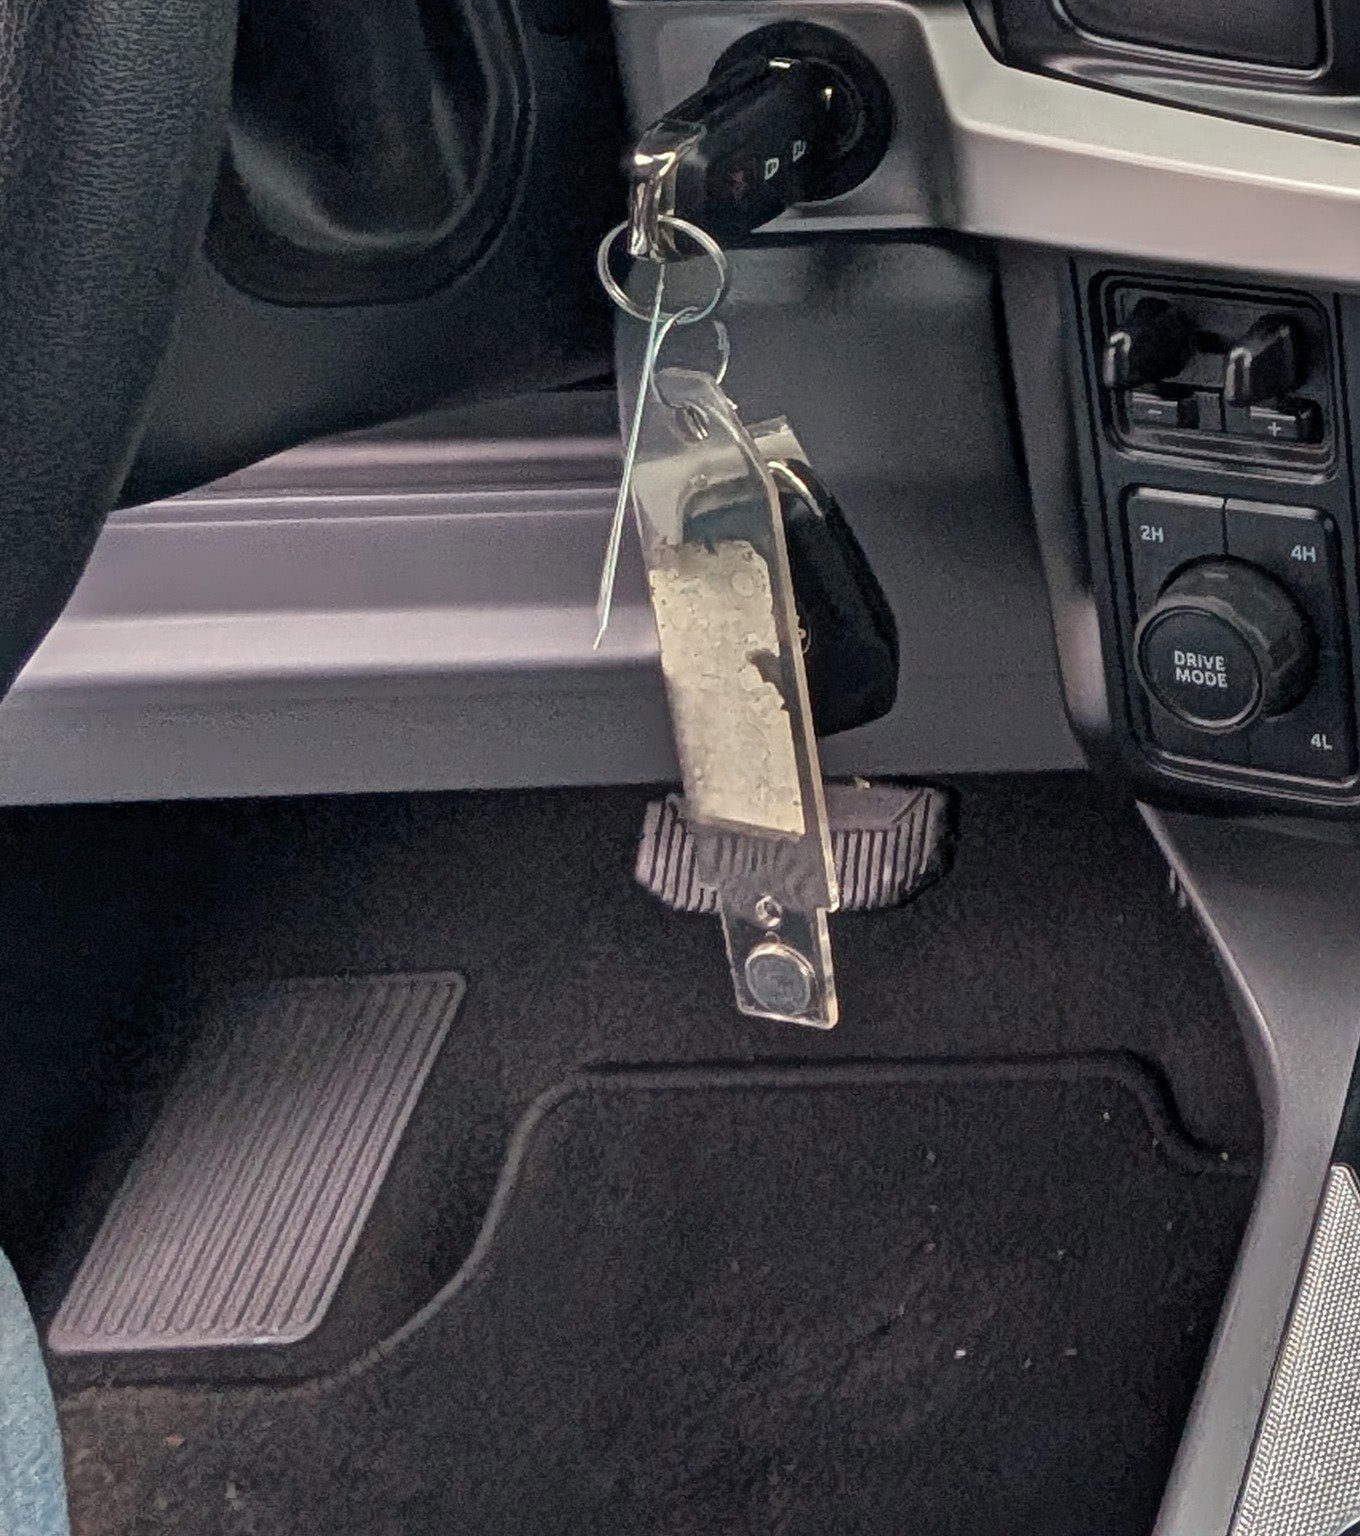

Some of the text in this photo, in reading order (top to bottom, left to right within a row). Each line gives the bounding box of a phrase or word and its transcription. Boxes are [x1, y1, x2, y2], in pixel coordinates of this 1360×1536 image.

[1140, 524, 1164, 543] 2H
[1290, 544, 1317, 562] 4H
[1173, 650, 1226, 672] DRIVE
[1175, 668, 1229, 689] MODE
[1310, 733, 1334, 750] 4L
